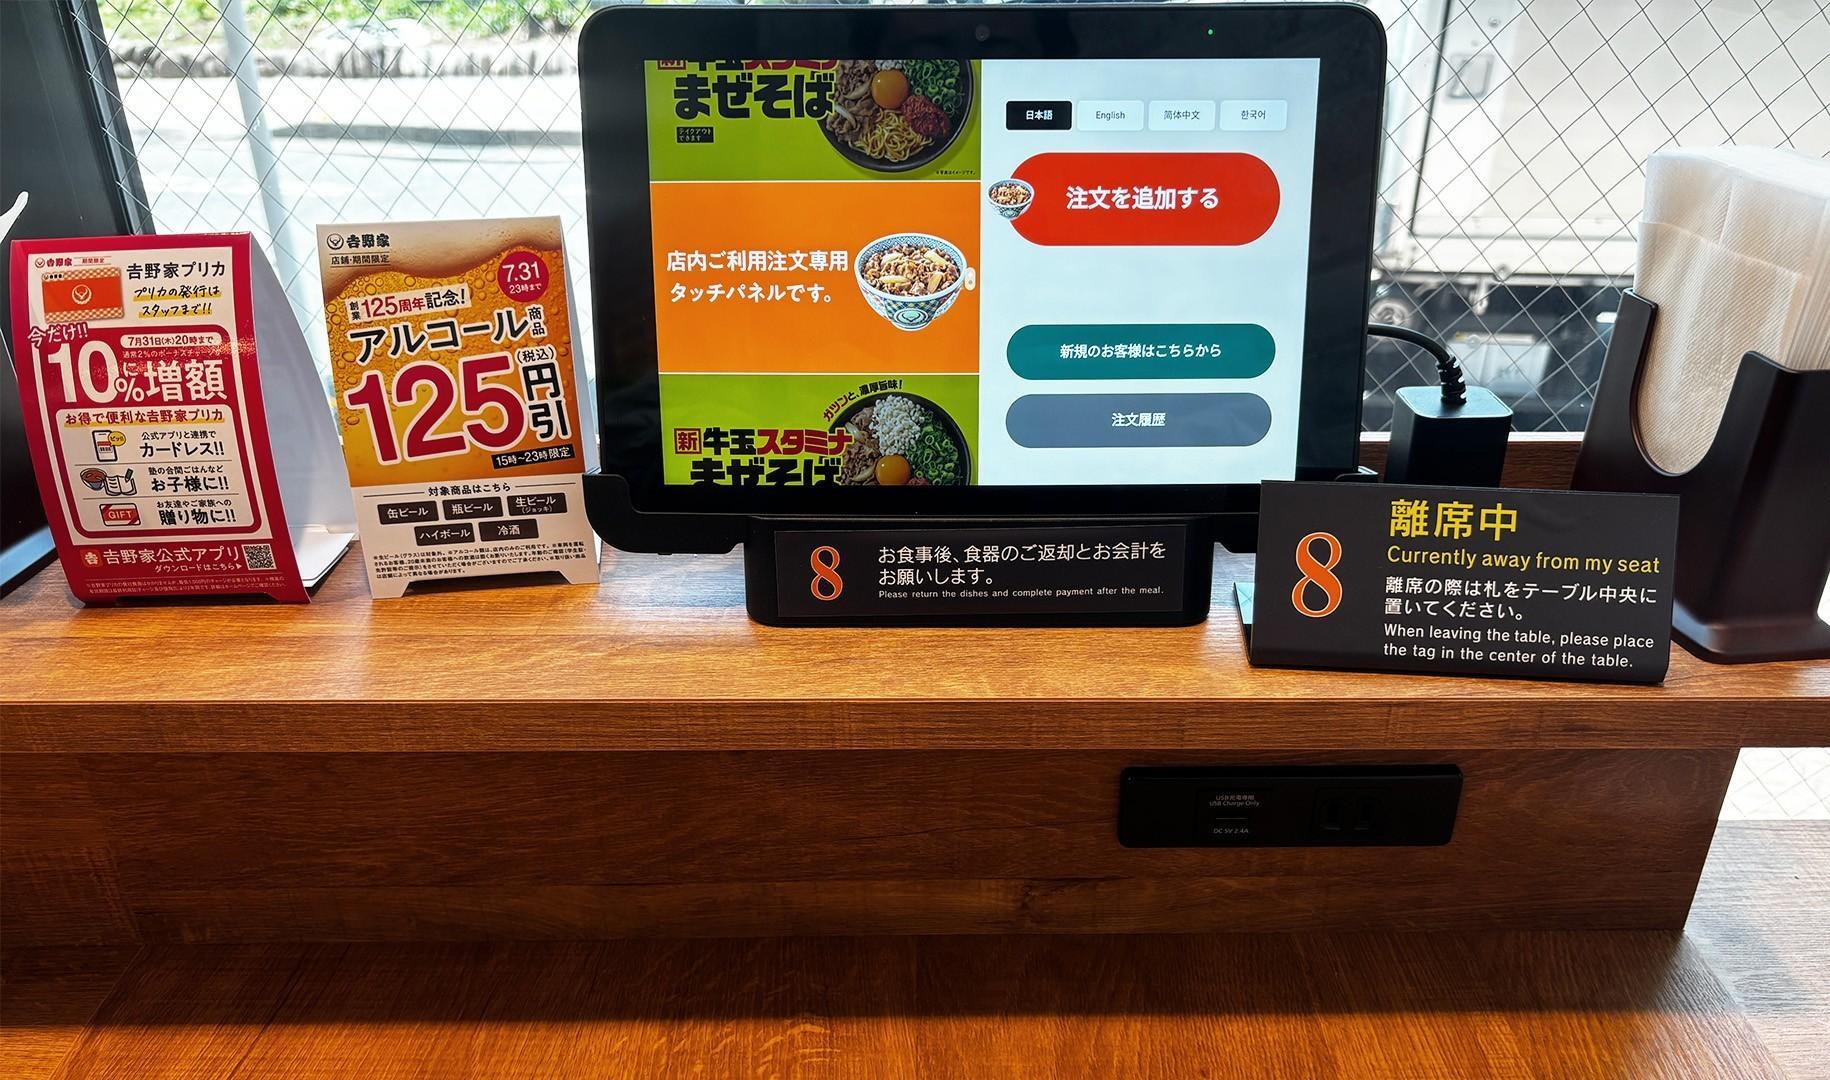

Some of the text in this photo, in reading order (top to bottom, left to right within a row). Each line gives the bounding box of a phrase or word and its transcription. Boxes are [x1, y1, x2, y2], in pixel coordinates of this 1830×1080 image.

[674, 73, 836, 118] まぜそば
[1026, 110, 1052, 120] 日本語
[1096, 110, 1125, 120] English
[1164, 110, 1200, 120] 简体中文
[1241, 110, 1266, 120] 한국어
[1066, 186, 1218, 210] 注文を追加する
[666, 250, 848, 272] 店内ご利用注文専用
[126, 261, 226, 280] 吉野家プリカ
[502, 261, 540, 282] 7.31
[134, 285, 220, 298] プリカの発行は
[509, 282, 541, 294] 23時まで
[670, 283, 832, 303] タッチパネルです。
[141, 303, 212, 317] スタッフまで!!
[27, 323, 89, 348] 今だけ!!
[1060, 344, 1222, 359] 新規のお客様はこちらから
[64, 409, 224, 426] お得で便利な吉野家プリカ
[1112, 412, 1166, 427] 注文履歴
[141, 430, 216, 440] 公式アプリと連携で
[678, 427, 853, 456] 新 牛玉スタミナ
[140, 442, 225, 458] カードレス!!
[148, 465, 224, 476] 塾の合間ごはんなど
[151, 476, 230, 492] お子様に!!
[428, 482, 511, 497] 対象商品はこちら
[156, 500, 232, 508] お友達やご家族への
[452, 504, 494, 515] 瓶ビール
[516, 496, 556, 508] 生ビール
[108, 510, 132, 520] GIFT
[159, 509, 236, 526] 贈り物に!!
[387, 508, 429, 520] 缶ビール
[1389, 499, 1518, 542] 離席中
[419, 529, 470, 540] ハイボール
[498, 524, 520, 536] 冷酒
[103, 544, 240, 565] 吉野家公式アプリ
[878, 541, 1166, 564] お食事後、食器のご返却とお会計を
[155, 562, 234, 573] ダウンロードはこちら
[1387, 546, 1660, 576] Currently away from my seat
[810, 545, 844, 601] 8
[878, 568, 994, 586] お願いします。
[1290, 531, 1343, 618] 8
[878, 586, 1164, 598] Please return the dishes and complete payment after the meal.
[1384, 576, 1658, 604] 離席の際は札をテーブル中央に
[1384, 598, 1523, 622] 置いてください。
[1384, 624, 1654, 650] When leaving the table, please place
[1384, 643, 1633, 668] the tag in the center of the table.
